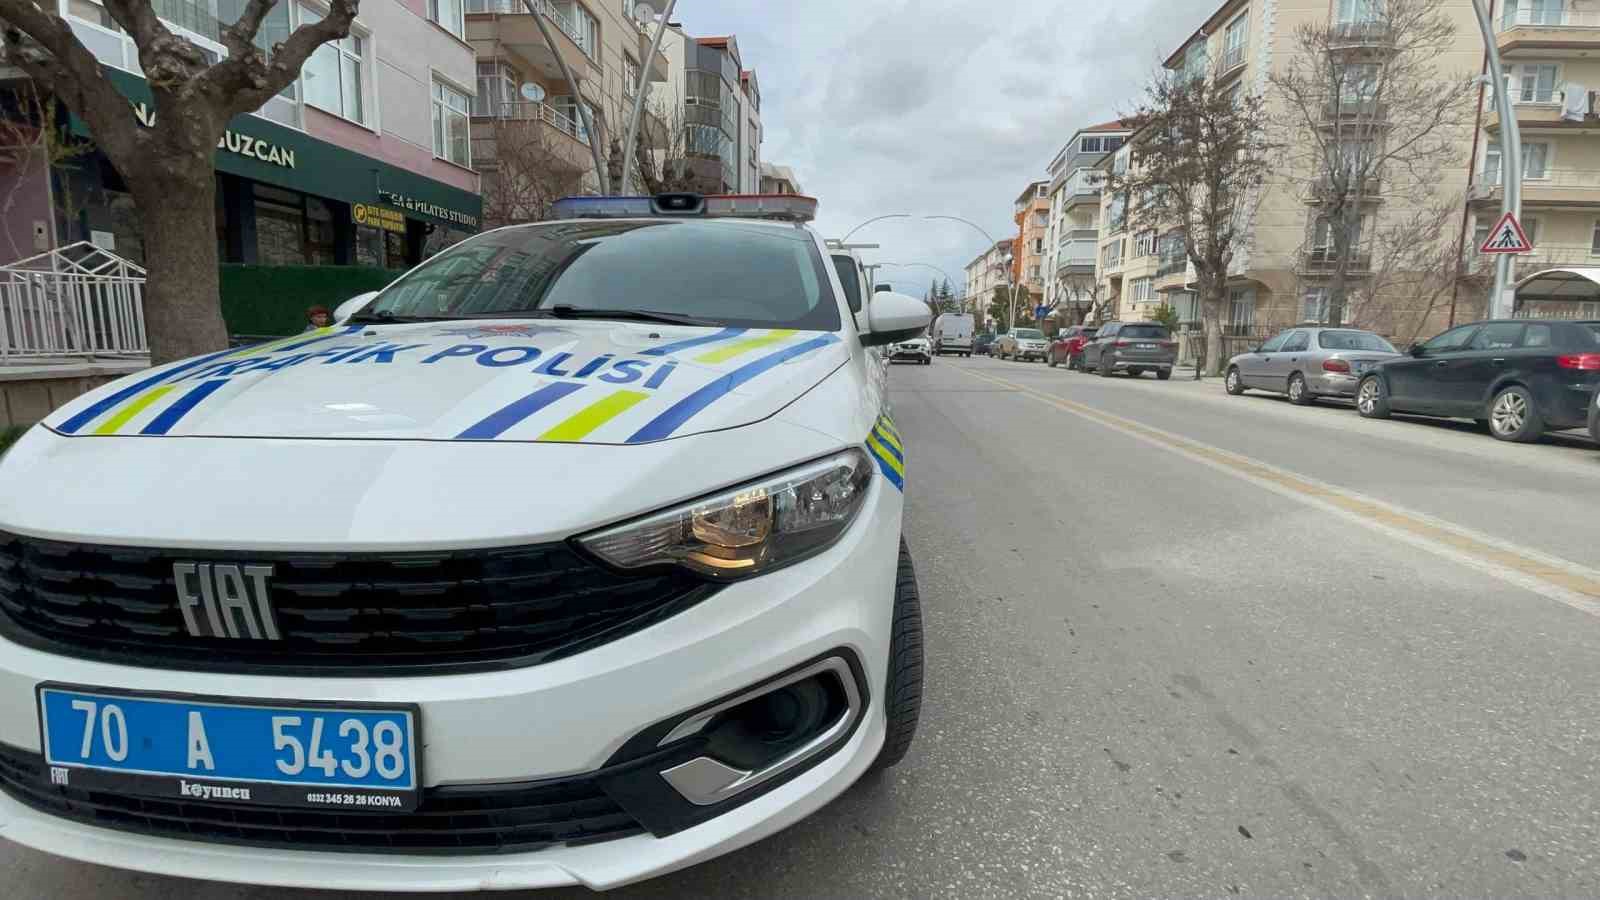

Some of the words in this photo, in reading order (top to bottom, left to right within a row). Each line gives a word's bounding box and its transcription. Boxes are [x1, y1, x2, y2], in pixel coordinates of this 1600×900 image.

[415, 200, 449, 220] PILATES
[449, 211, 478, 226] STUDIO
[420, 344, 679, 390] POLİSİ
[173, 562, 281, 640] FIAT
[71, 699, 129, 762] 70
[187, 711, 216, 770] A
[271, 715, 406, 780] 5438
[325, 793, 343, 804] 345
[367, 796, 402, 808] KONYA
